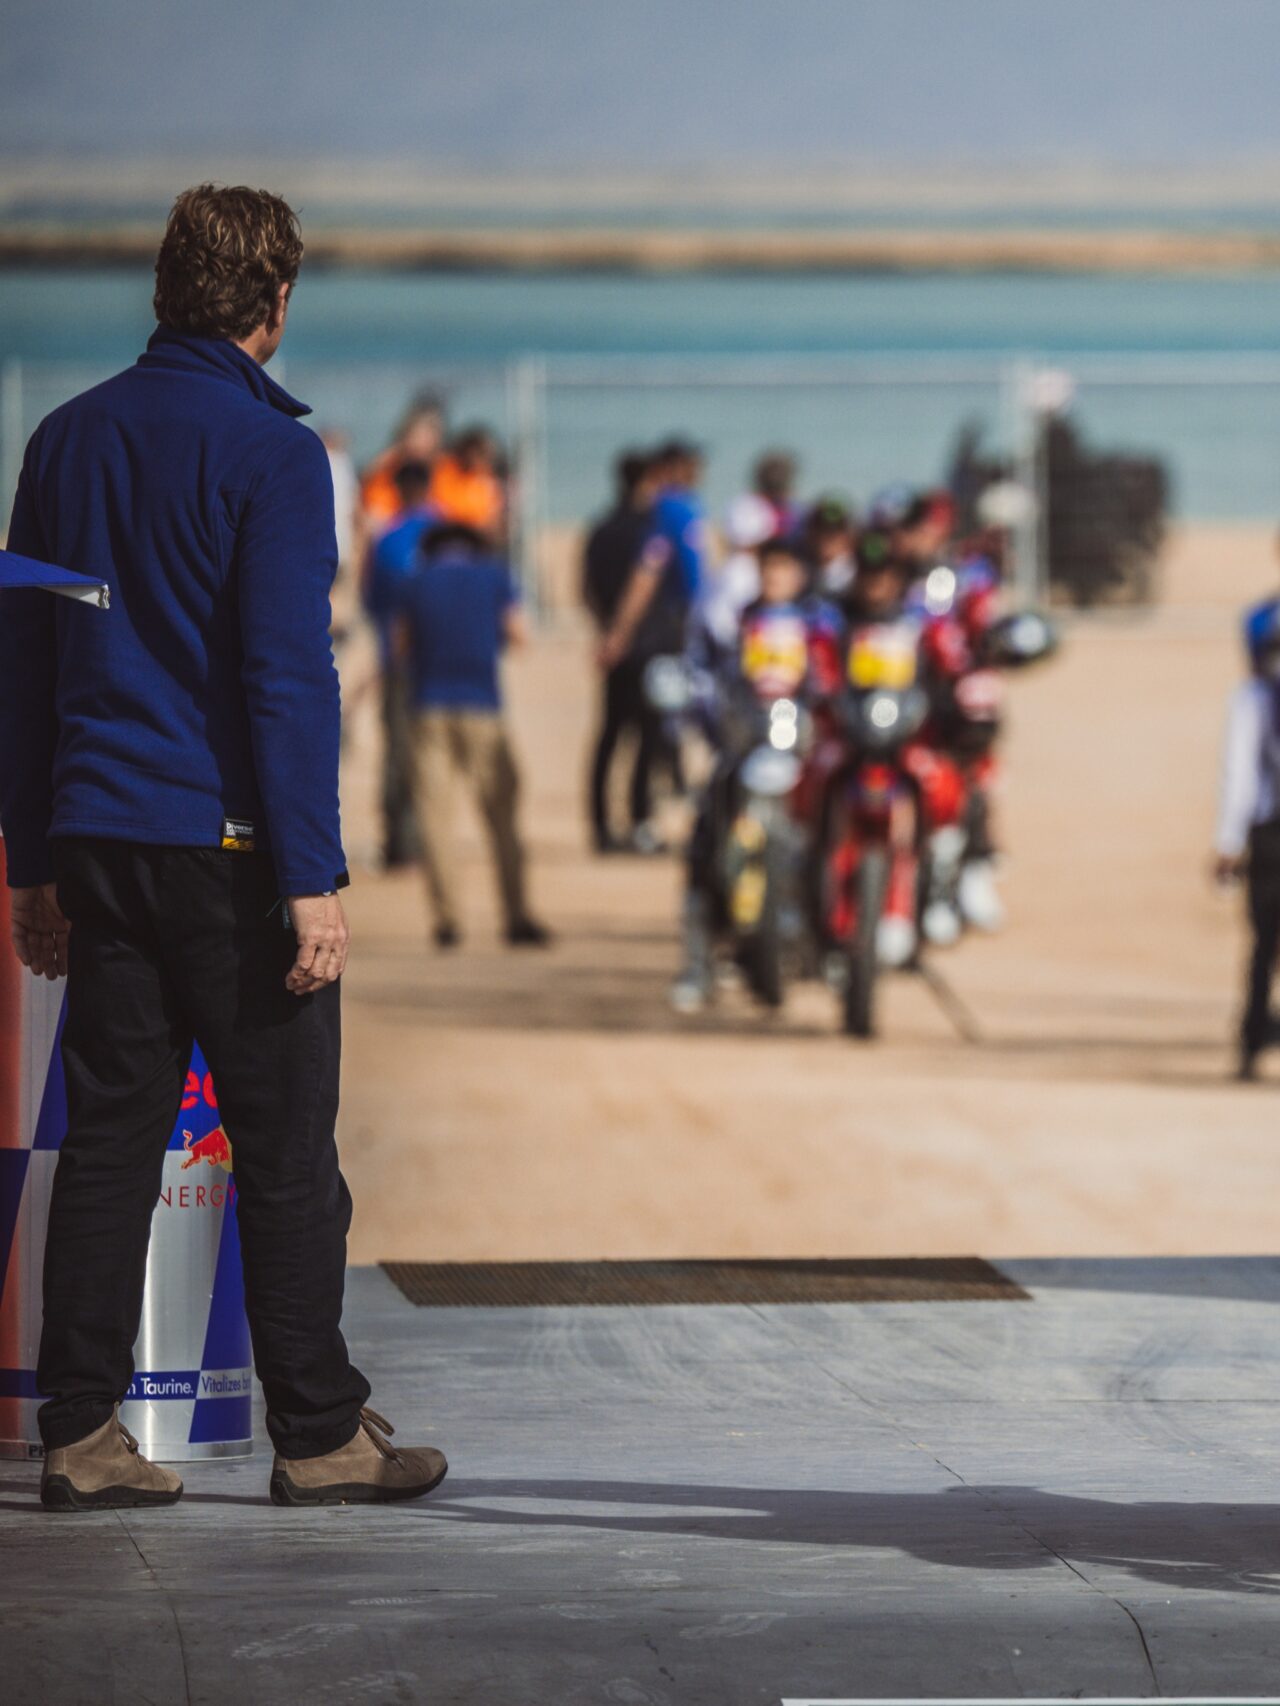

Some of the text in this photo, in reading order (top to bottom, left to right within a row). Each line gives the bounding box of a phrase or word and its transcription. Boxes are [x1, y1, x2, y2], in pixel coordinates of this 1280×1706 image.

[160, 1185, 237, 1208] NERGY
[140, 1377, 194, 1395] Taurine.
[201, 1372, 242, 1393] Vitalizes
